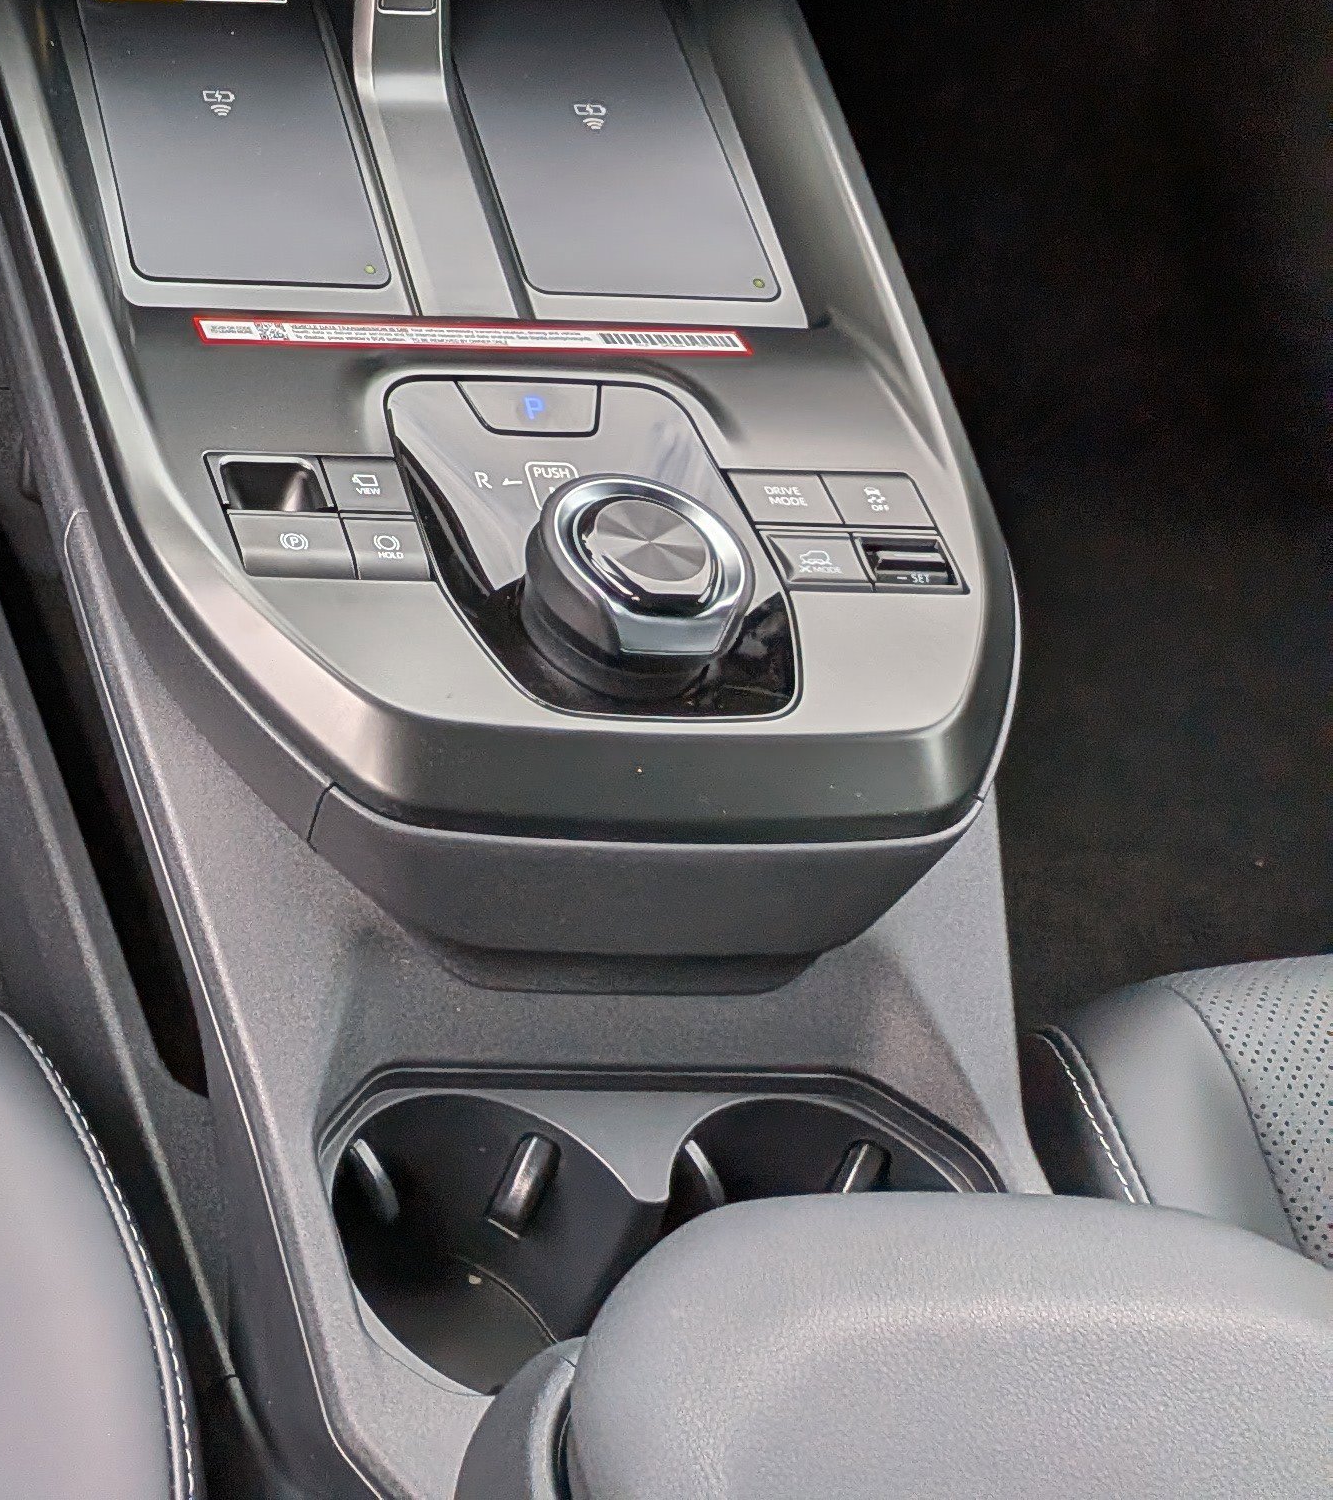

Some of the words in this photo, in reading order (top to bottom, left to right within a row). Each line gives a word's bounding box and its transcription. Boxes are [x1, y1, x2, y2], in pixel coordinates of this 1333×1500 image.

[523, 396, 545, 420] P
[533, 467, 571, 479] PUSH
[474, 471, 493, 489] R
[356, 487, 381, 495] VIEW
[764, 486, 802, 496] DRIVE
[768, 496, 808, 507] MODE
[870, 504, 889, 512] OFF
[377, 551, 404, 559] HOLD
[910, 573, 930, 584] SET
